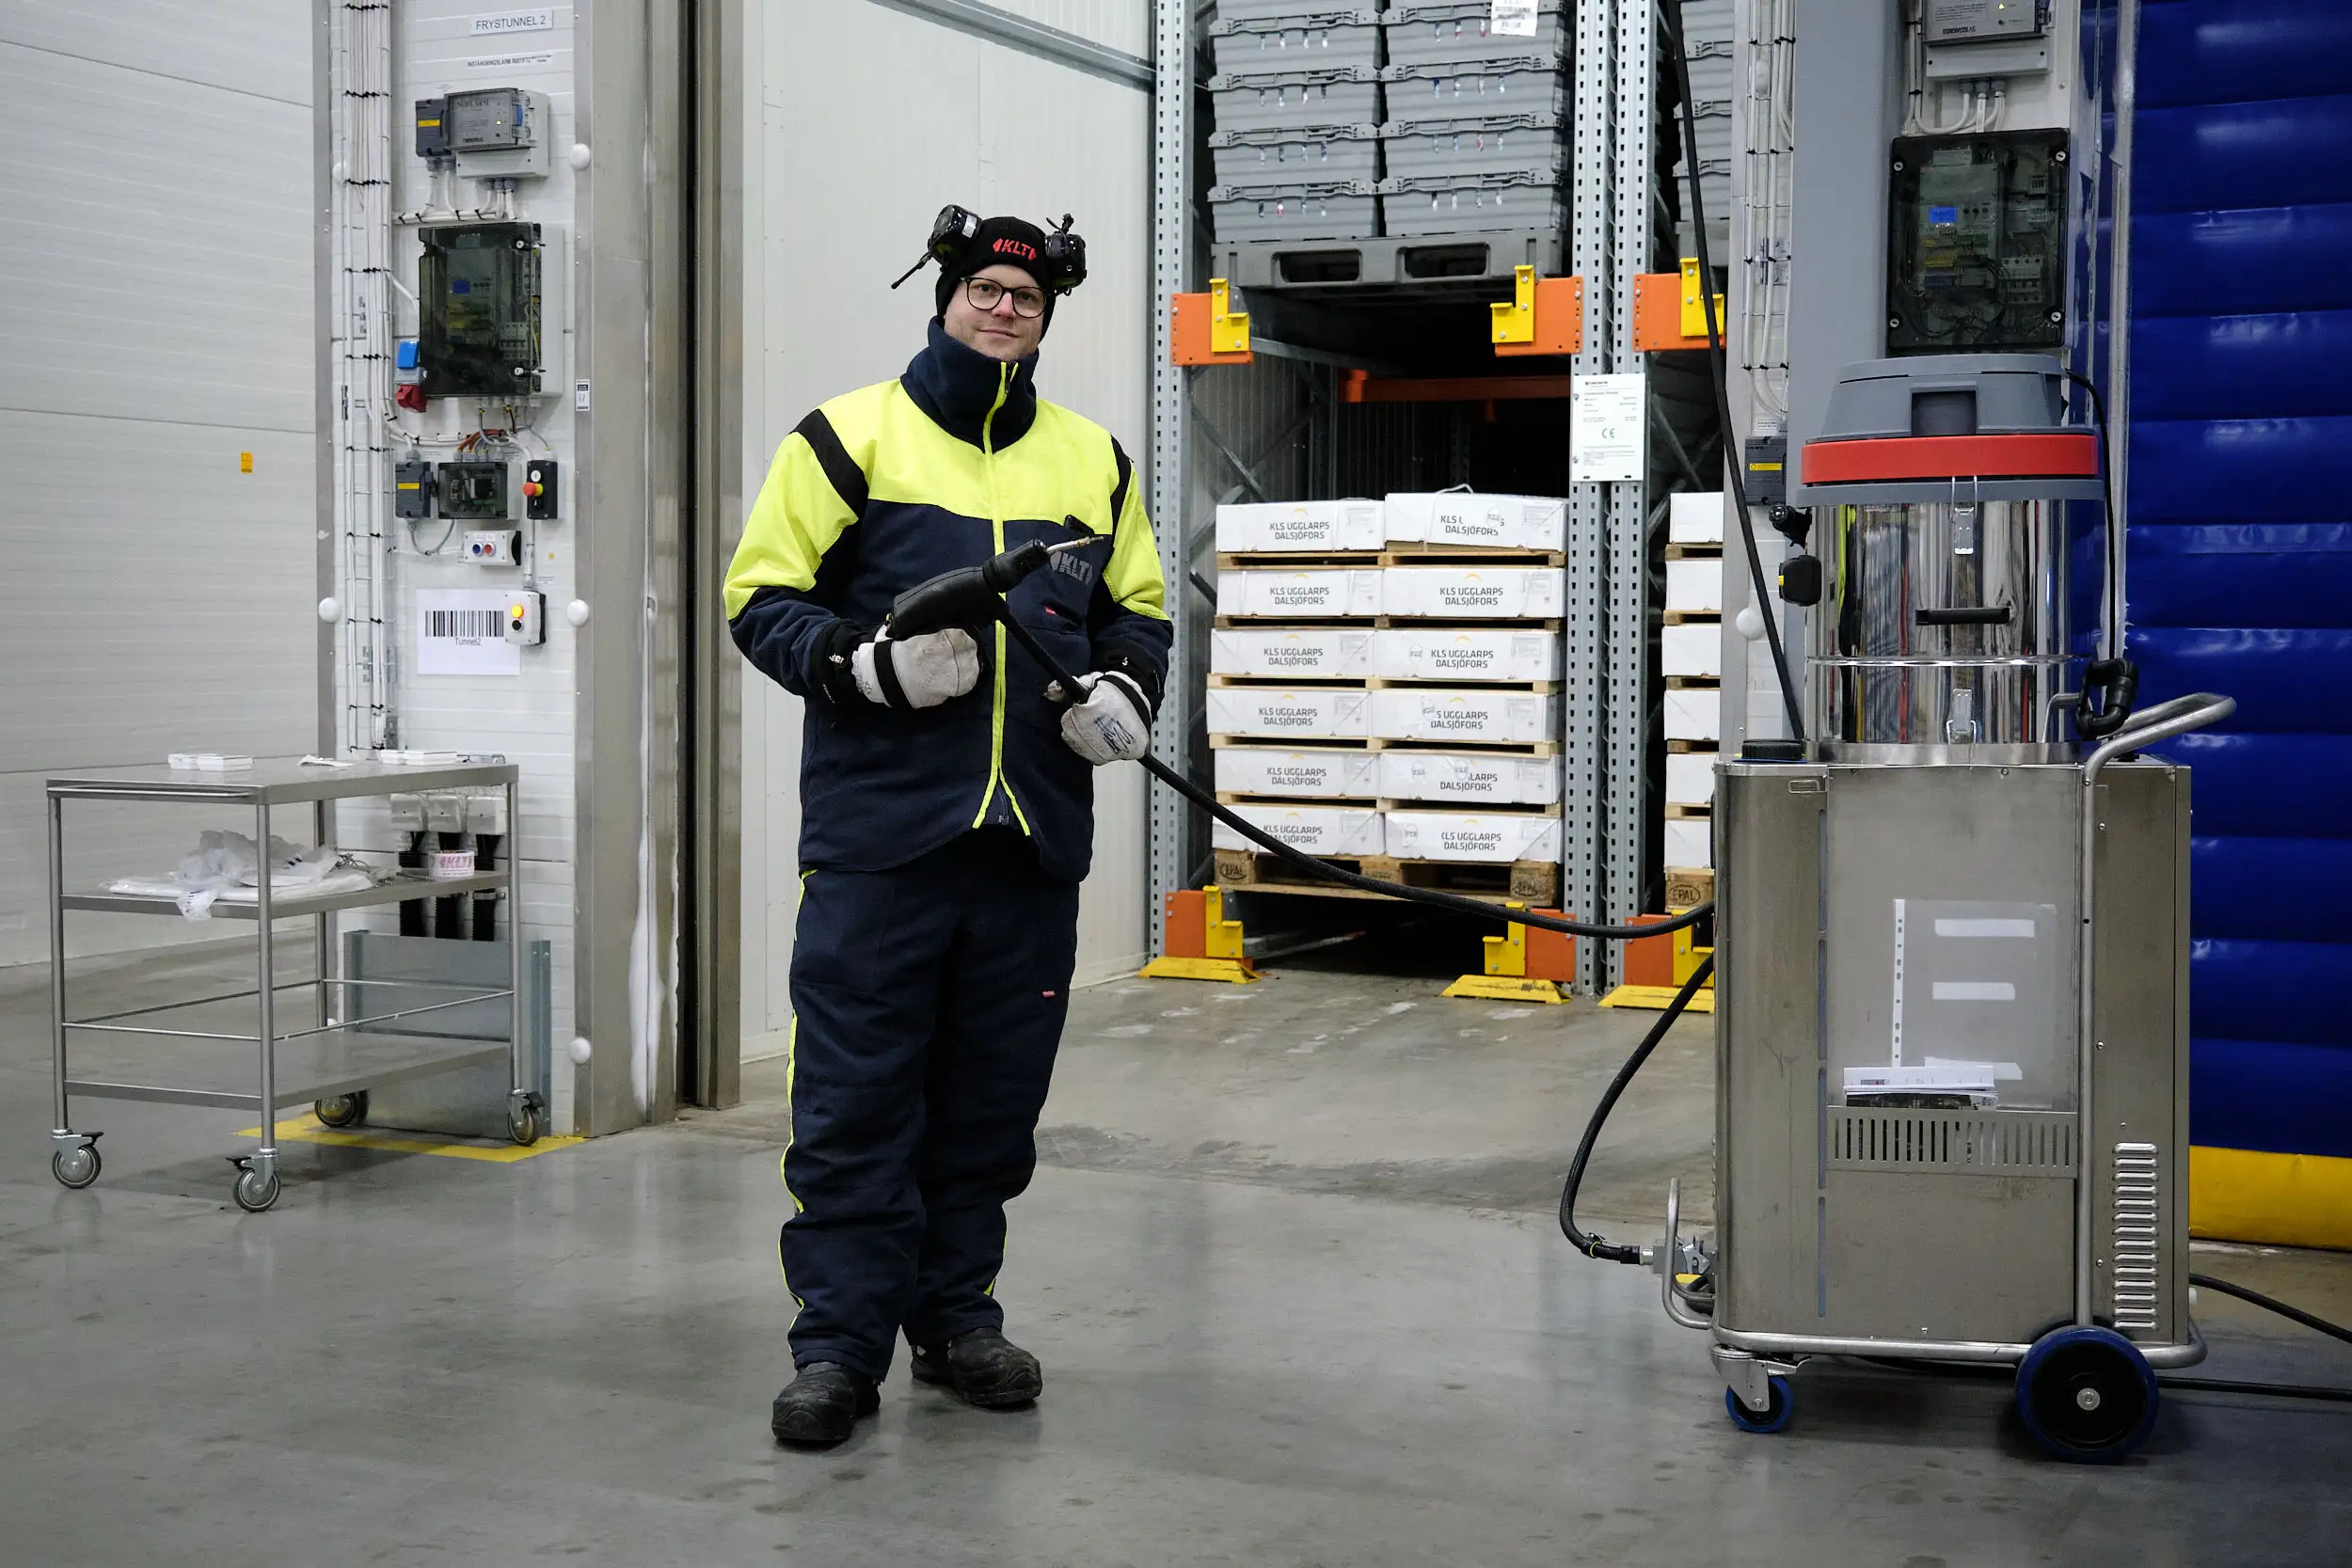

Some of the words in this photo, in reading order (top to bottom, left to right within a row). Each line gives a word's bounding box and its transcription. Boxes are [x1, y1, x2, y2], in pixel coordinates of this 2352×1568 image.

[476, 16, 538, 30] FRYSTUNNEL
[540, 15, 546, 24] 2
[1001, 239, 1031, 256] KLT
[1441, 515, 1456, 524] KLS
[1270, 522, 1285, 531] KLS
[1287, 522, 1329, 531] UGGLARPS
[1275, 531, 1325, 541] DALSJÖFORS
[1058, 552, 1089, 581] KLT
[1270, 587, 1285, 595] KLS
[1287, 587, 1329, 595] UGGLARPS
[1439, 587, 1455, 595] KLS
[1458, 587, 1503, 595] UGGLARPS
[1275, 595, 1325, 606] DALSJÖFORS
[1445, 595, 1498, 607] DALSJÖFORS
[455, 638, 482, 646] Tunnel2
[1263, 648, 1279, 657] KLS
[1280, 648, 1323, 657] UGGLARPS
[1431, 649, 1446, 657] KLS
[1448, 649, 1494, 658] UGGLARPS
[1268, 657, 1318, 667] DALSJÖFORS
[1436, 659, 1488, 670] DALSJÖFORS
[1259, 707, 1274, 716] KLS
[1276, 707, 1318, 717] UGGLARPS
[1443, 711, 1488, 720] UGGLARPS
[1263, 717, 1312, 727] DALSJÖFORS
[1266, 767, 1282, 776] KLS
[1284, 768, 1327, 777] UGGLARPS
[1271, 777, 1322, 787] DALSJÖFORS
[1469, 773, 1498, 782] LARPS
[1439, 782, 1492, 792] DALSJÖFORS
[1263, 825, 1279, 833] KLS
[1280, 826, 1323, 834] UGGLARPS
[1272, 835, 1318, 845] ALSJÖFORS
[1456, 832, 1502, 842] UGGLARPS
[1444, 842, 1496, 852] DALSJÖFORS
